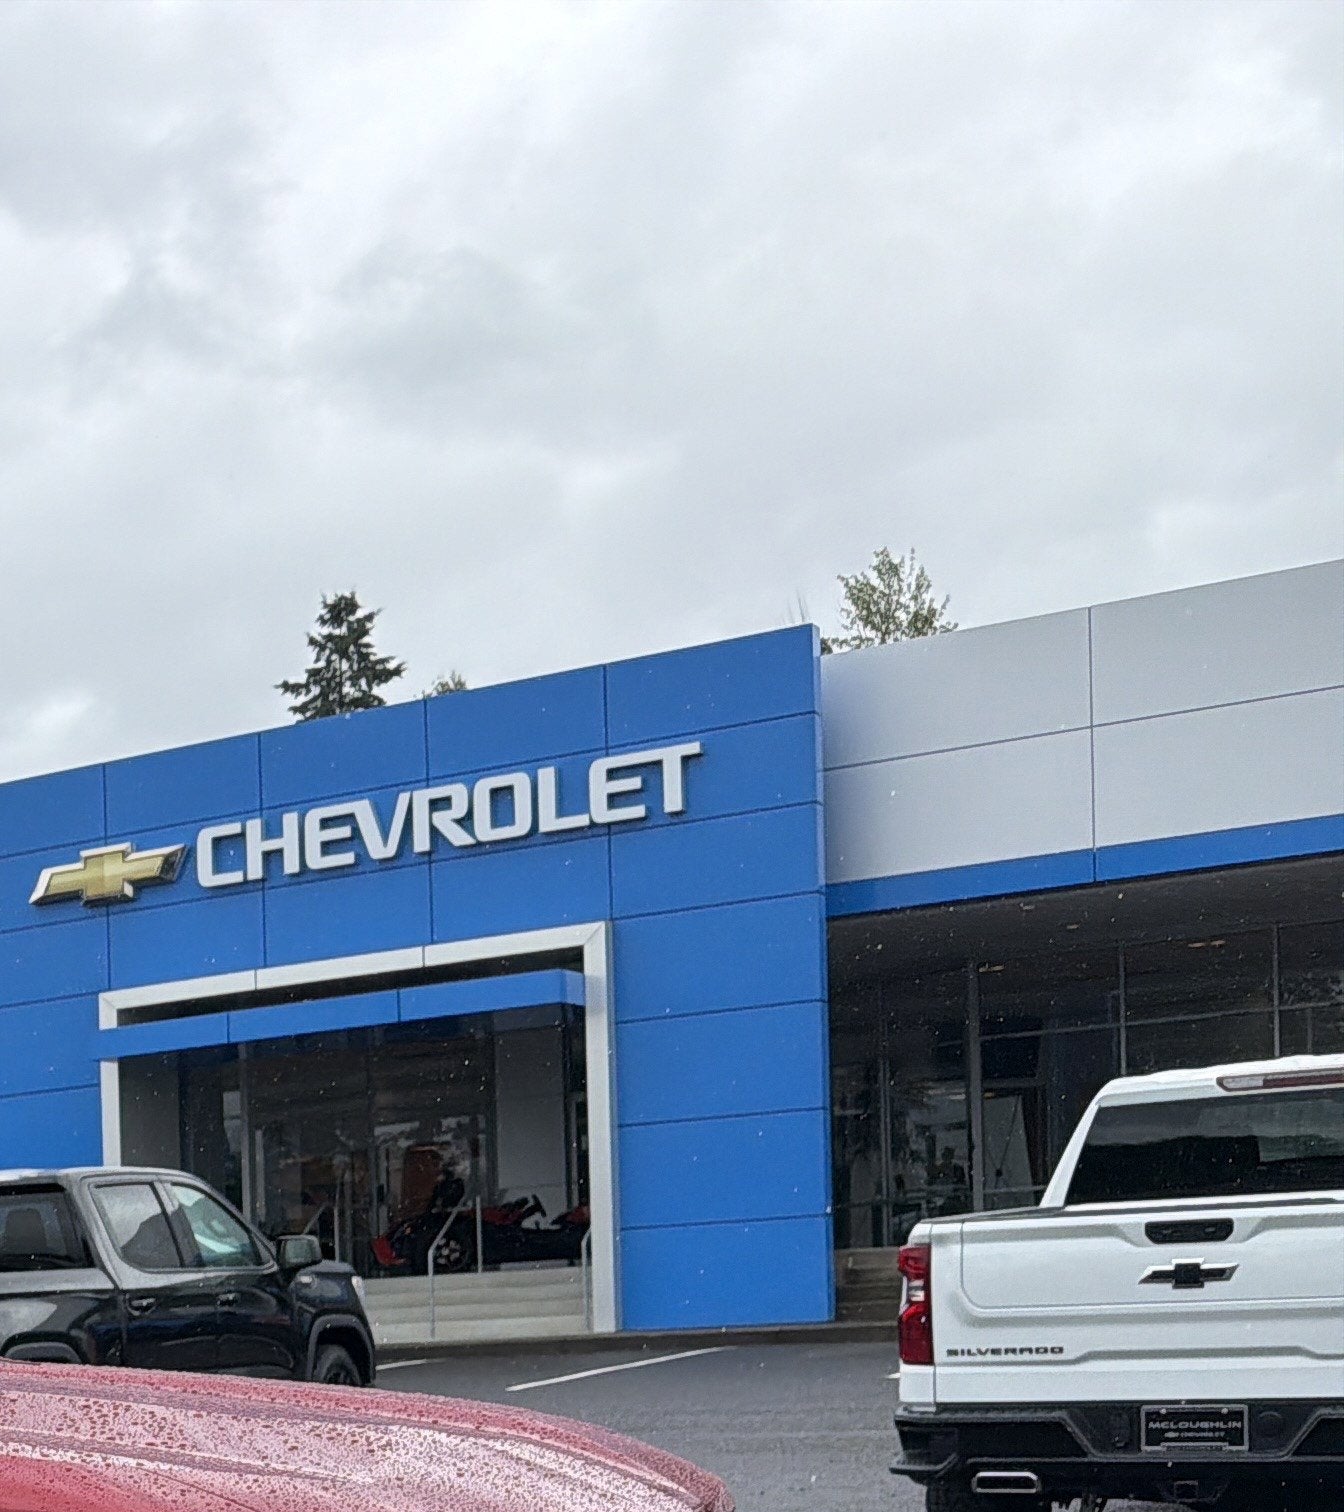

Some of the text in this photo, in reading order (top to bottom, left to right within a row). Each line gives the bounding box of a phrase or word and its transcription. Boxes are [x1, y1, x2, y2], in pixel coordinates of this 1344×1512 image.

[196, 741, 702, 888] CHEVROLET
[946, 1346, 1064, 1357] SILVERADO
[1148, 1420, 1242, 1429] MCLOUGHLIN
